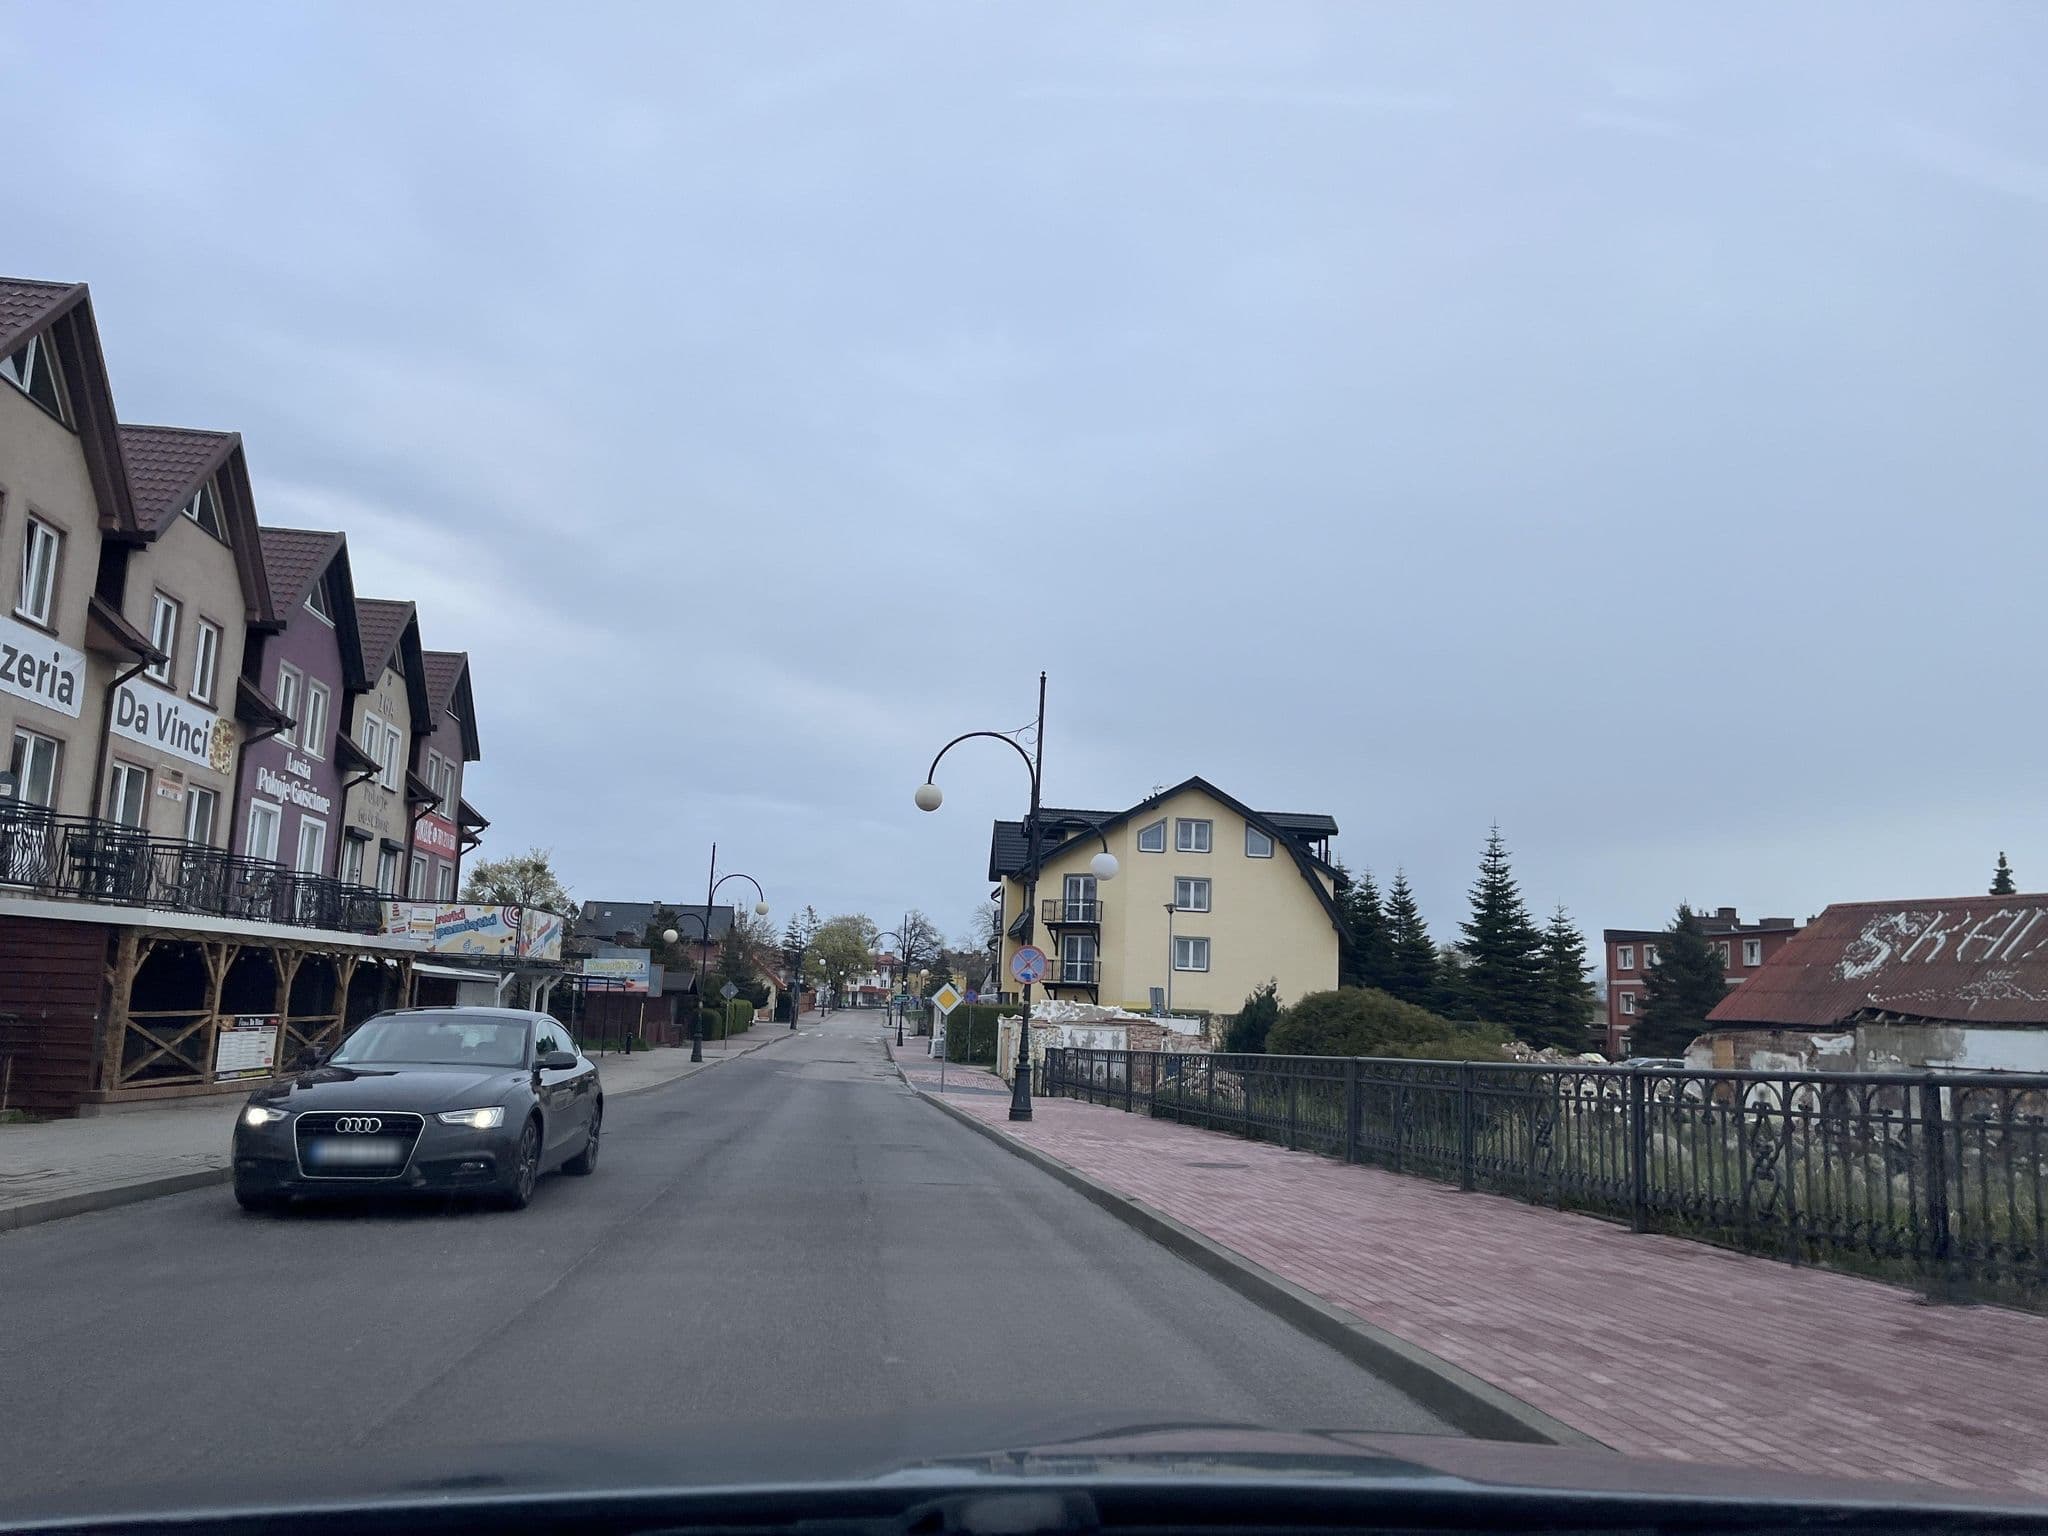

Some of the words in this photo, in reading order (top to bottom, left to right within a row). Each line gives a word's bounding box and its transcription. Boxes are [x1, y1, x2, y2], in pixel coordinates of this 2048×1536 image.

[0, 642, 75, 706] zeria
[116, 686, 149, 736] Da
[156, 702, 211, 758] Vinci
[285, 752, 311, 780] Lusia
[256, 767, 290, 804] Pokoje
[291, 780, 331, 815] Gościnne
[436, 913, 498, 939] pamiątki
